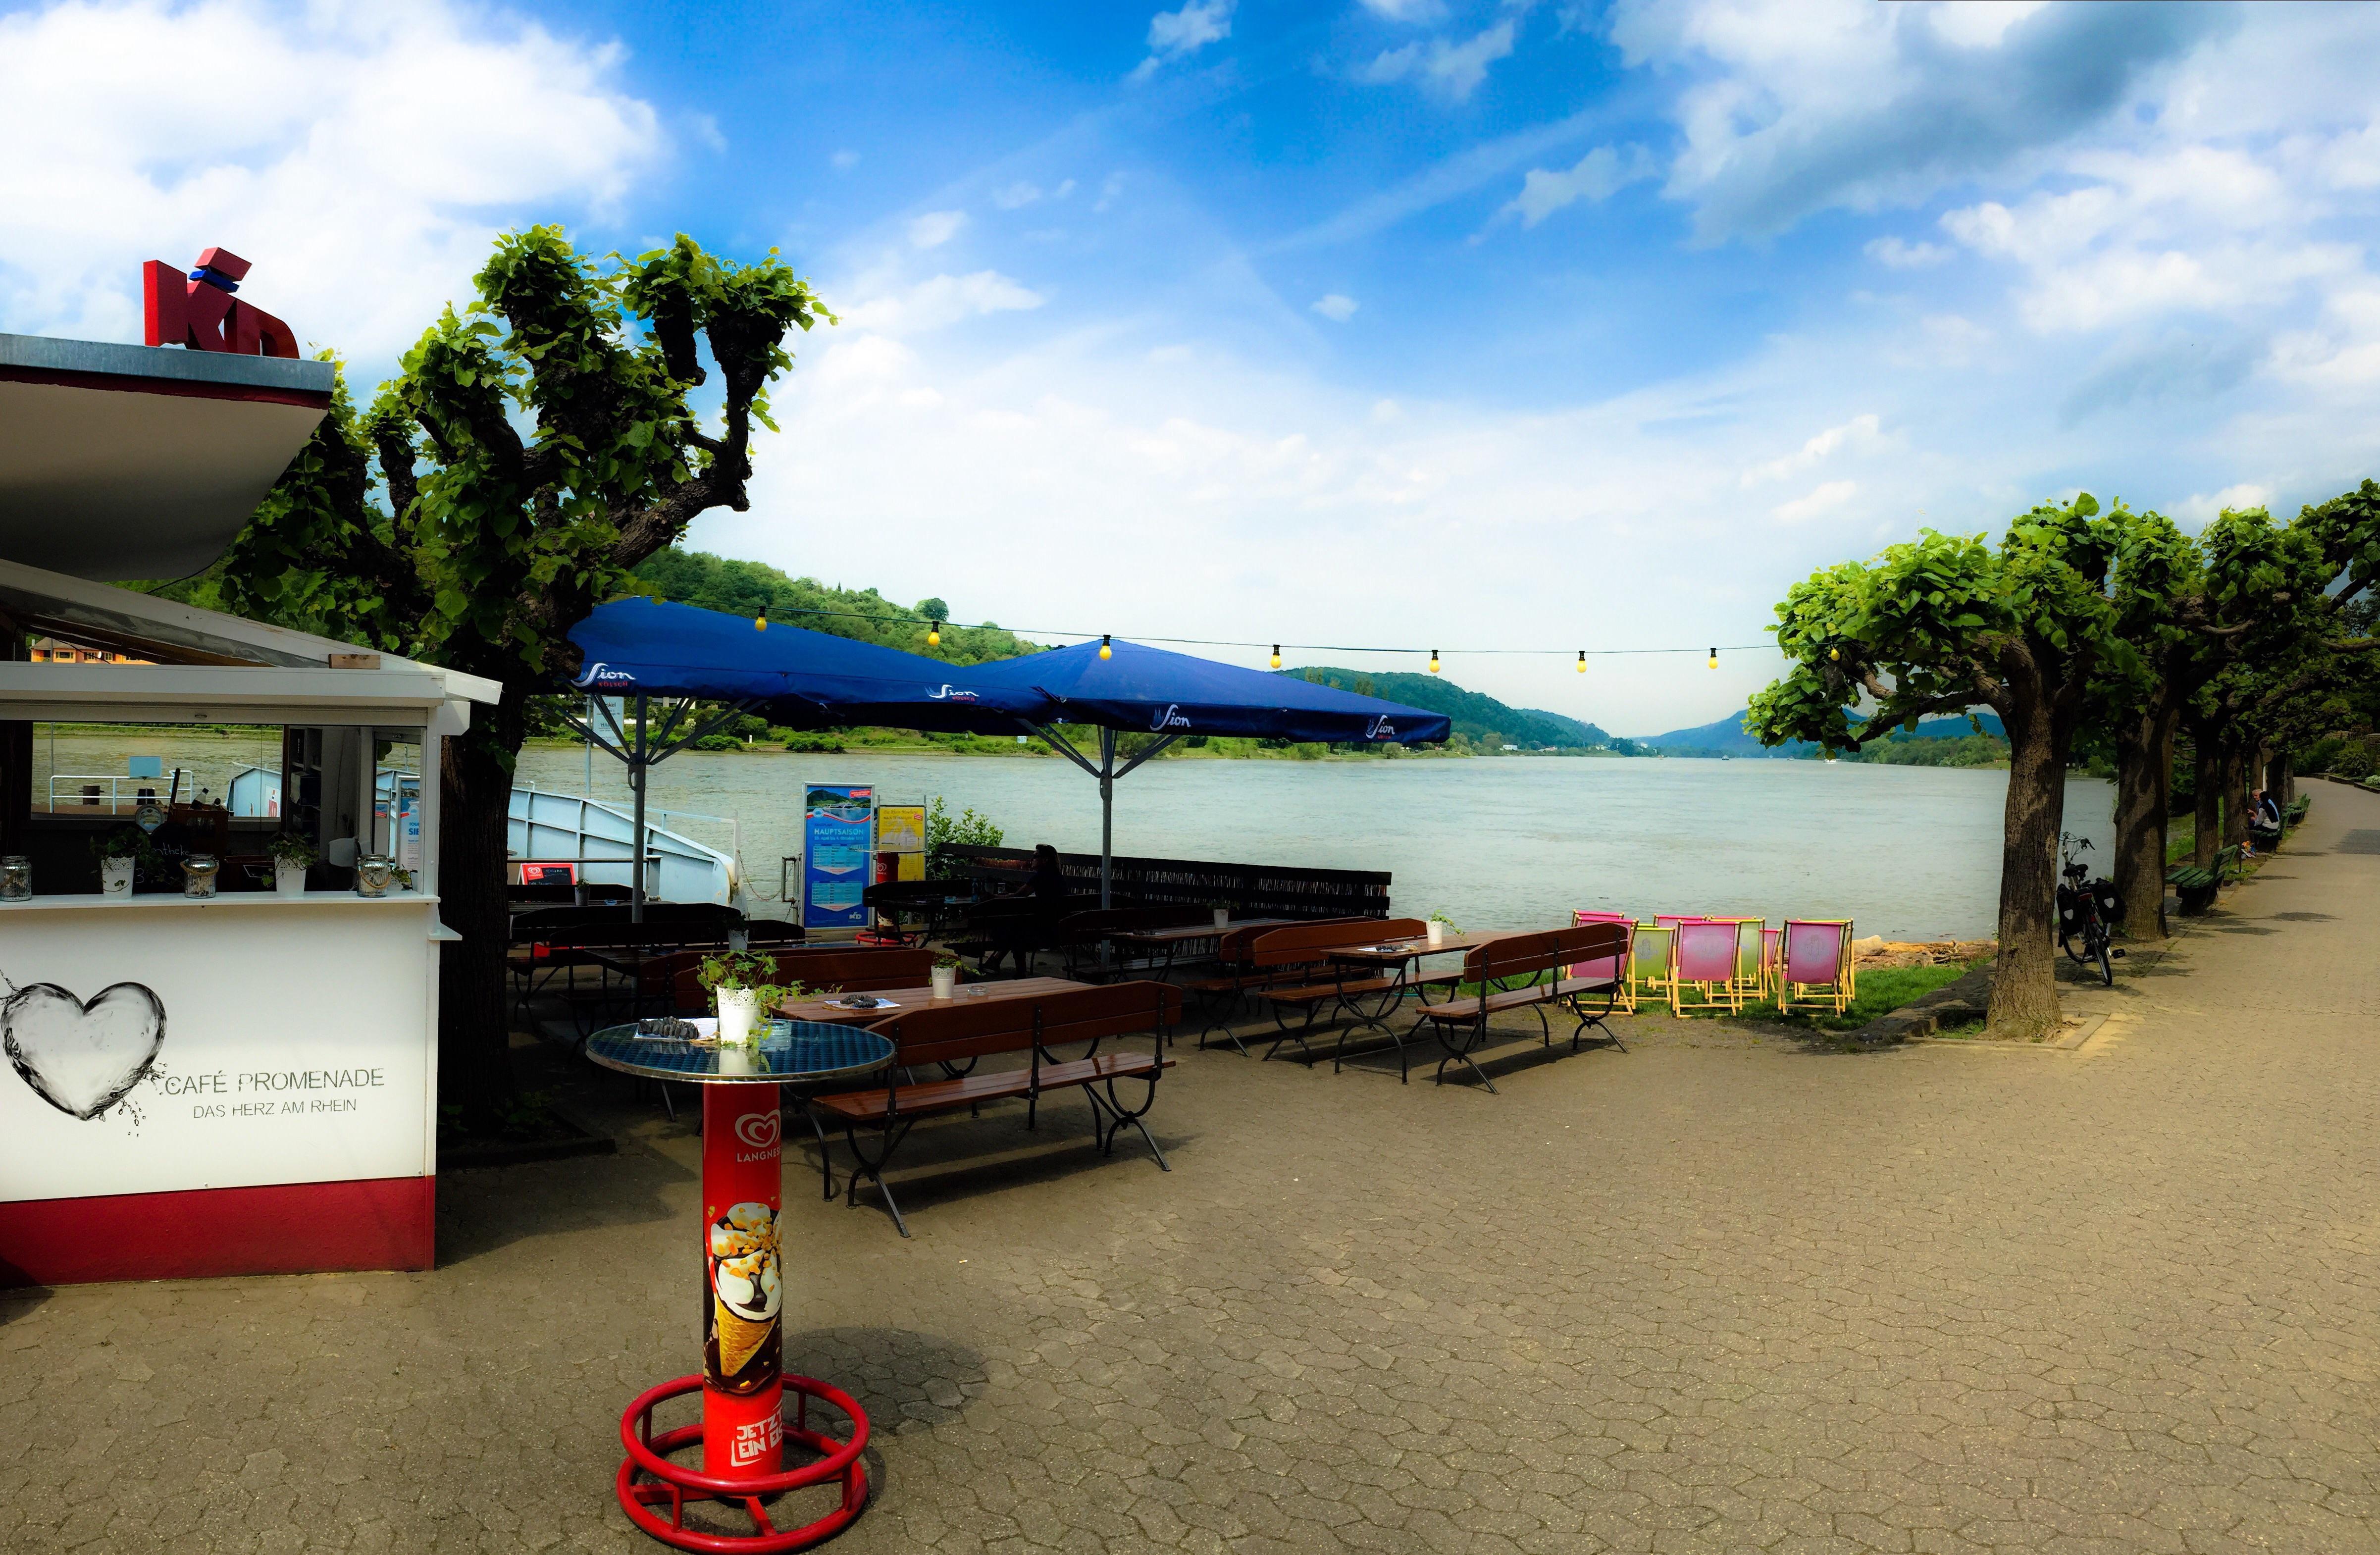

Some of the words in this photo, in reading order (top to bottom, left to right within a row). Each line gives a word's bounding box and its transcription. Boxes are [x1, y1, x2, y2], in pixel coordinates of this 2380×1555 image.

[570, 663, 636, 687] Sion
[928, 684, 980, 699] Sion
[1149, 704, 1191, 731] Sion
[1365, 715, 1395, 739] Sion
[165, 1070, 228, 1095] CAFÉ
[238, 1068, 385, 1092] PROMENADE
[194, 1104, 225, 1118] DAS
[232, 1102, 275, 1116] HERZ
[281, 1101, 304, 1114] AM
[310, 1098, 356, 1113] RHEIN
[736, 1406, 782, 1441] JETZT
[738, 1437, 767, 1458] EIN
